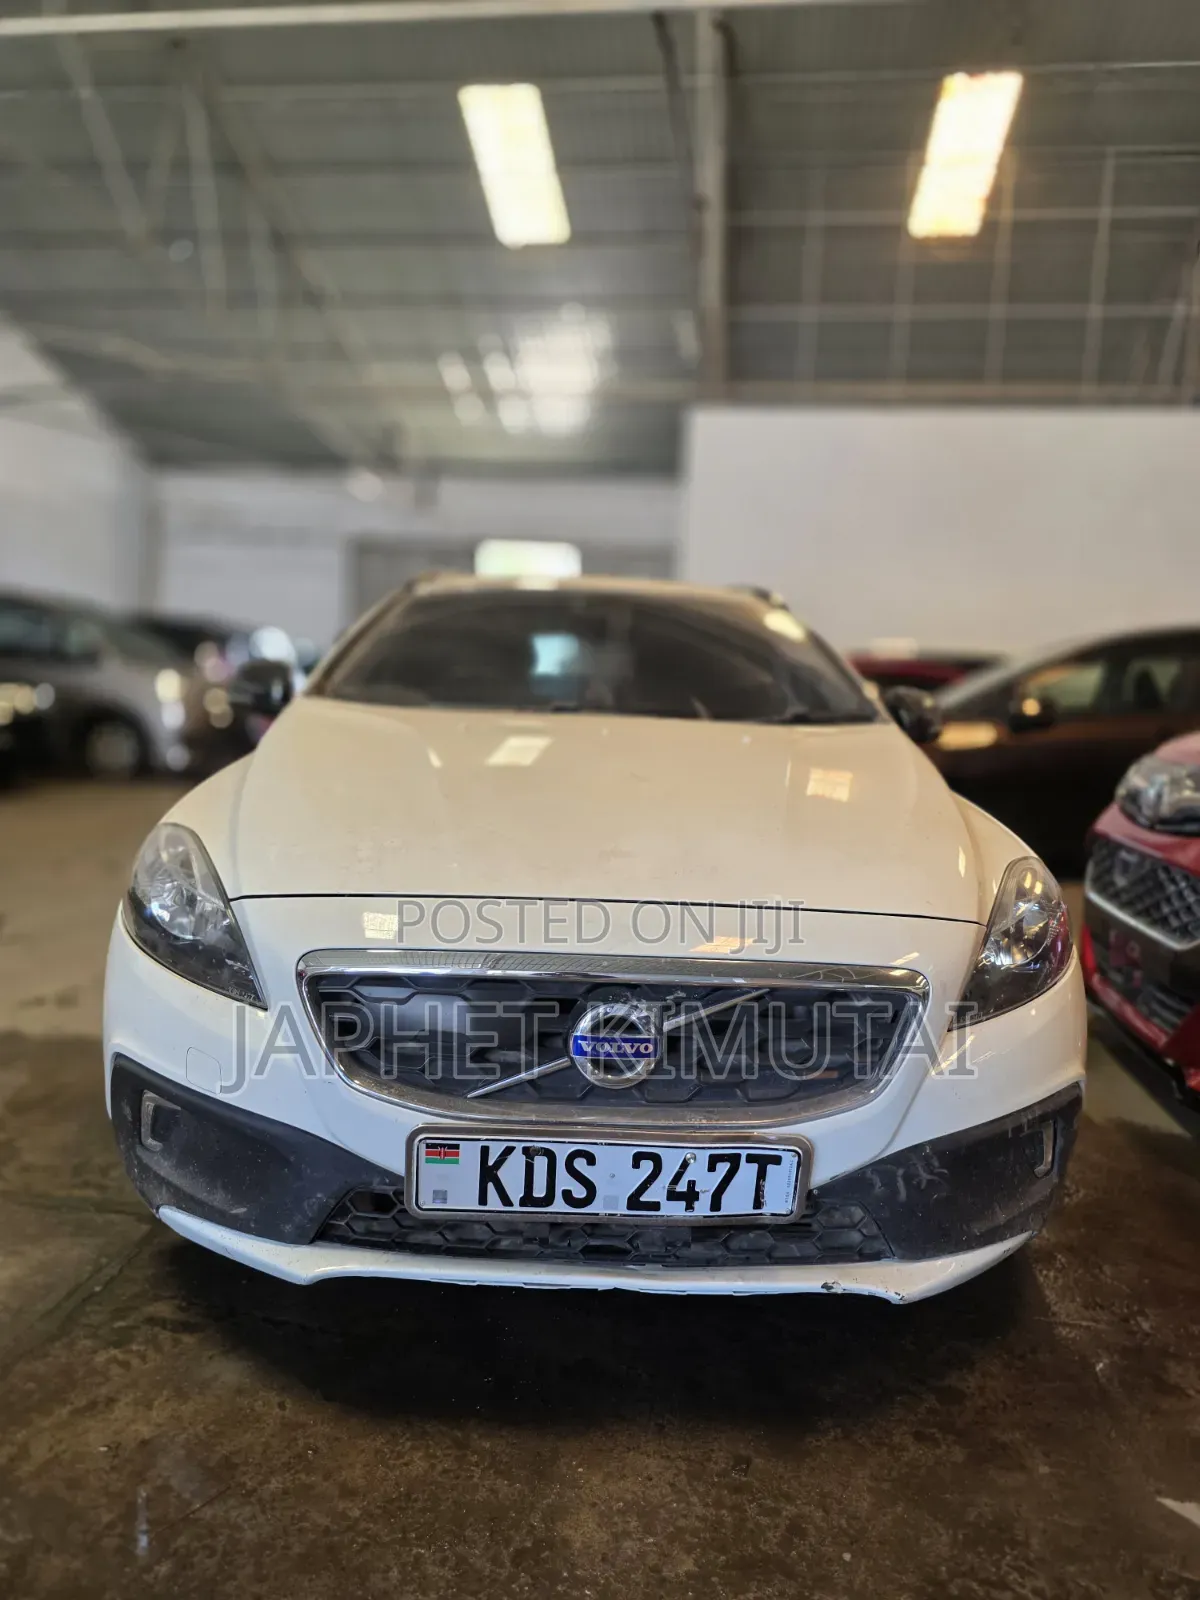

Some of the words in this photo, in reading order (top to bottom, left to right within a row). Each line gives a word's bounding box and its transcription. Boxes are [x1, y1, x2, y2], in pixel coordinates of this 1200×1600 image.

[577, 1040, 654, 1054] VOLVO
[477, 1144, 598, 1210] KDS
[626, 1150, 783, 1213] 247T
